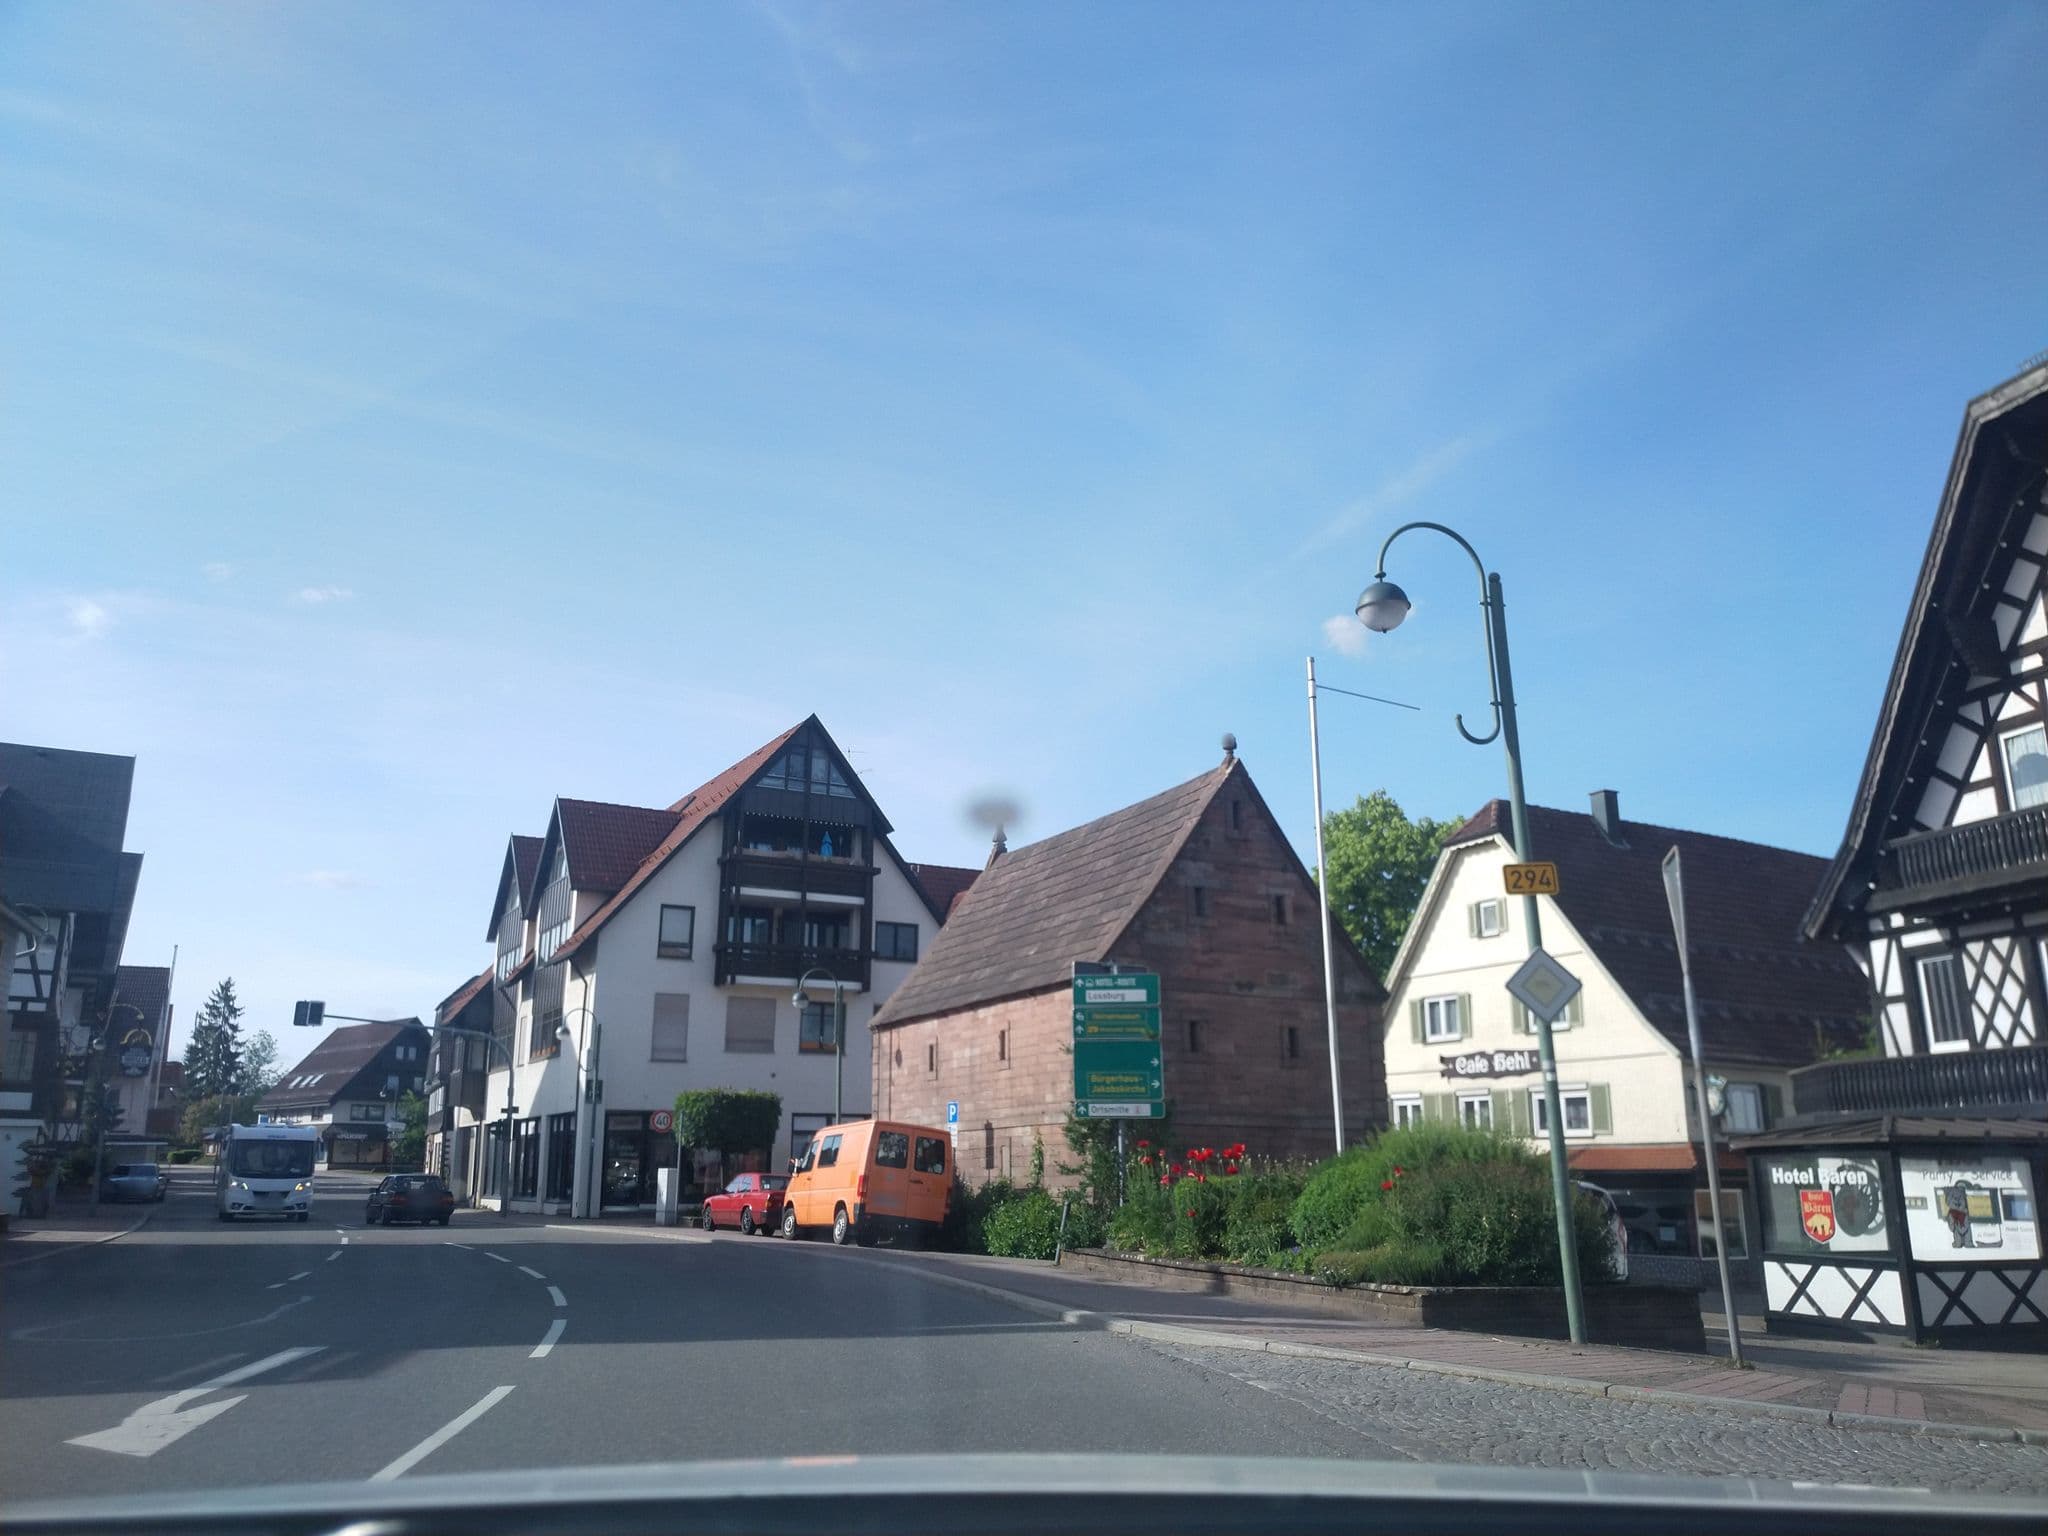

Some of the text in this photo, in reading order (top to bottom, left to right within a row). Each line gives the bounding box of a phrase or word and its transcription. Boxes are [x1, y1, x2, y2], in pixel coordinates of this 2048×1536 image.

[1510, 869, 1553, 889] 294
[656, 1114, 669, 1126] 40
[949, 1104, 957, 1121] P
[1772, 1167, 1814, 1185] Hotel
